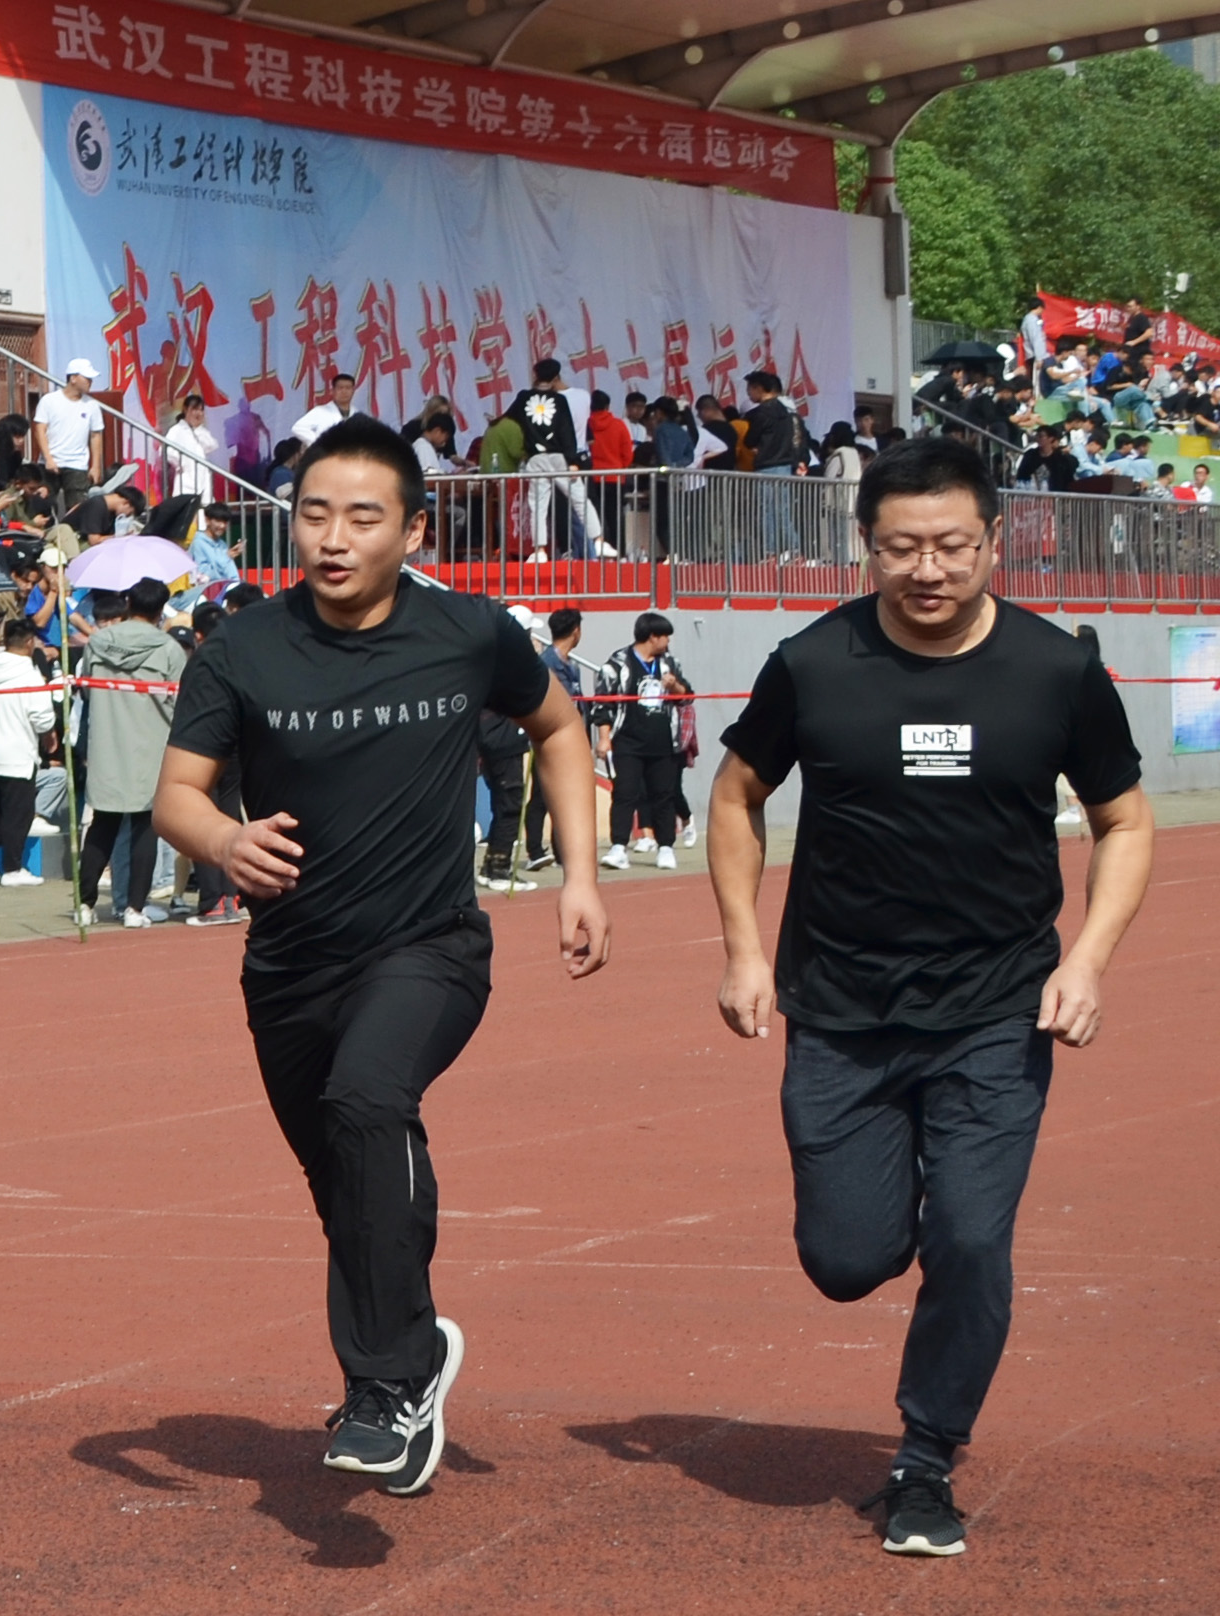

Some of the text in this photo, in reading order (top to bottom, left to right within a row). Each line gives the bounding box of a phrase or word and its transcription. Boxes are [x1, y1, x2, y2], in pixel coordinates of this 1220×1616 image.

[267, 697, 447, 731] WAY OF WADE
